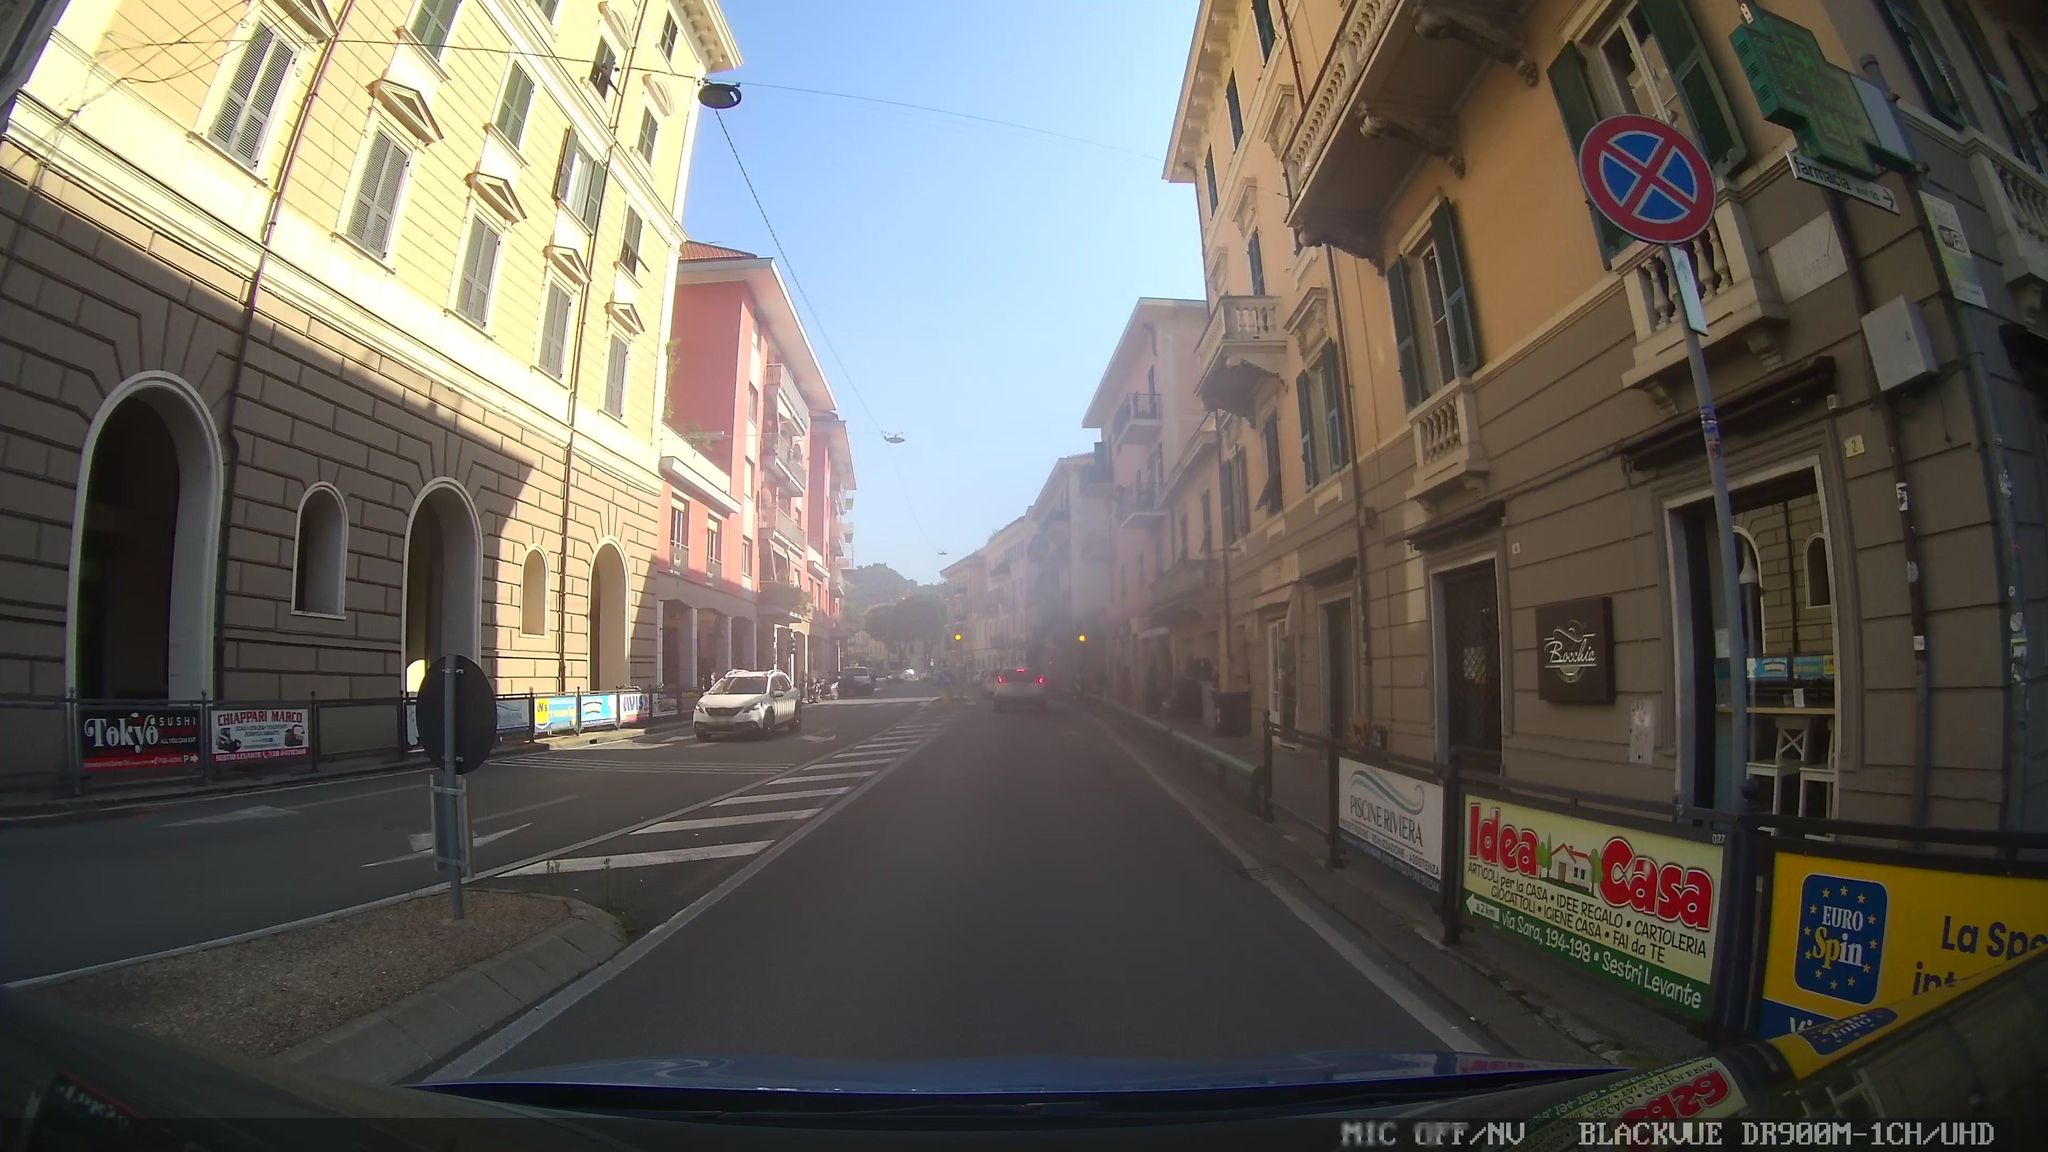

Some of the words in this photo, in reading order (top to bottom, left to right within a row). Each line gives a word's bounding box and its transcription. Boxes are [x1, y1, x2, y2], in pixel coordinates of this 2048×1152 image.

[1794, 156, 1851, 190] farmacia
[1544, 638, 1596, 663] Bocchia
[84, 714, 158, 753] Tokyo
[159, 717, 196, 726] SUSHI
[217, 710, 267, 726] CHIAPPARI
[271, 710, 302, 723] MARCO
[1350, 794, 1383, 827] PISCINE
[1383, 808, 1424, 847] RIVIERA
[1712, 833, 1726, 844] 027
[1467, 802, 1540, 878] Idea
[1600, 836, 1714, 932] Casa
[1467, 862, 1500, 882] ARTICOLI
[1501, 876, 1515, 891] per
[1517, 879, 1524, 893] la
[1525, 883, 1548, 903] CASA
[1556, 894, 1579, 914] IDEE
[1581, 901, 1623, 928] REGALO
[1634, 920, 1706, 958] CARTOLERIA
[1491, 886, 1536, 914] GIOCATTOLI
[1543, 905, 1574, 928] IGIENE
[1575, 917, 1601, 940] CASA
[1613, 930, 1629, 950] FAI
[1631, 939, 1645, 955] da
[1650, 943, 1665, 964] TE
[1822, 905, 1864, 932] EURO
[1813, 926, 1863, 970] Spin
[1941, 915, 1979, 954] La
[1517, 915, 1543, 945] Sara,
[1545, 927, 1591, 962] 194-198
[1602, 951, 1642, 985] Sestri
[1644, 967, 1701, 1009] Levante
